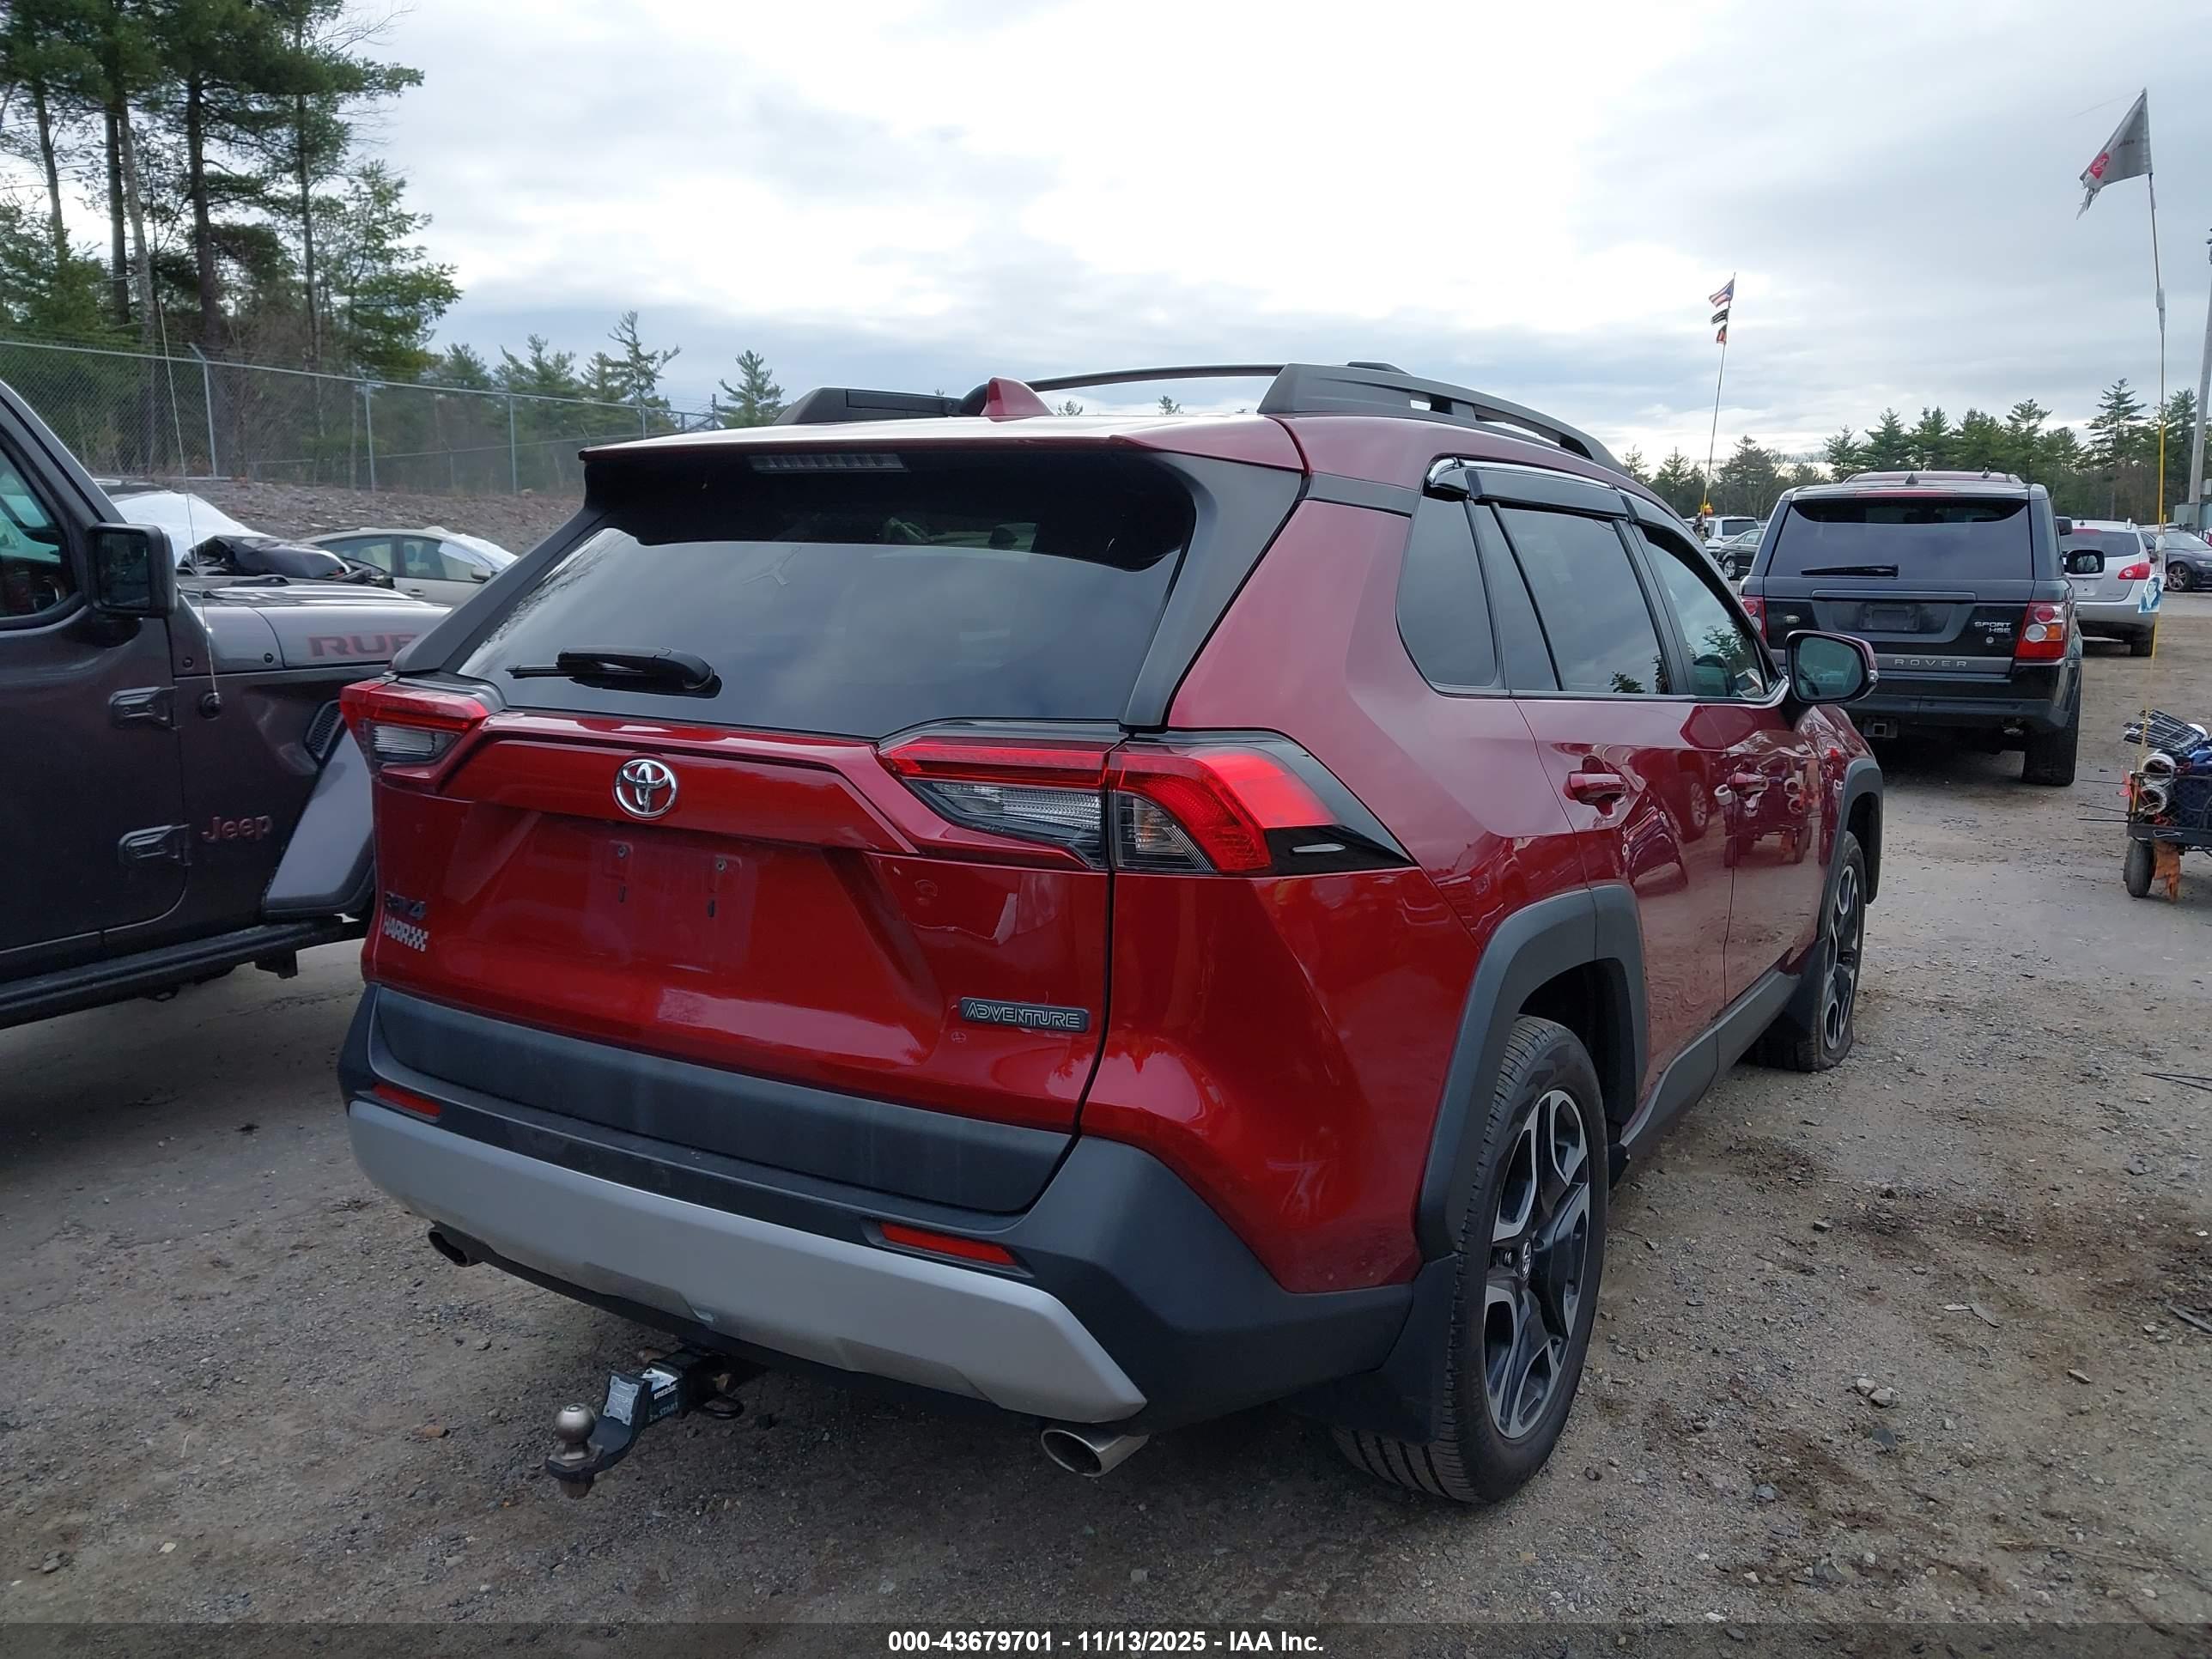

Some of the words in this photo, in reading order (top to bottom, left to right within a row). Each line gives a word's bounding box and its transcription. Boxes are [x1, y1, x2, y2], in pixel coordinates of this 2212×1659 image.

[1893, 659, 1967, 668] ROVER
[201, 816, 272, 842] Jeep
[965, 1001, 1080, 1029] ADVENTURE
